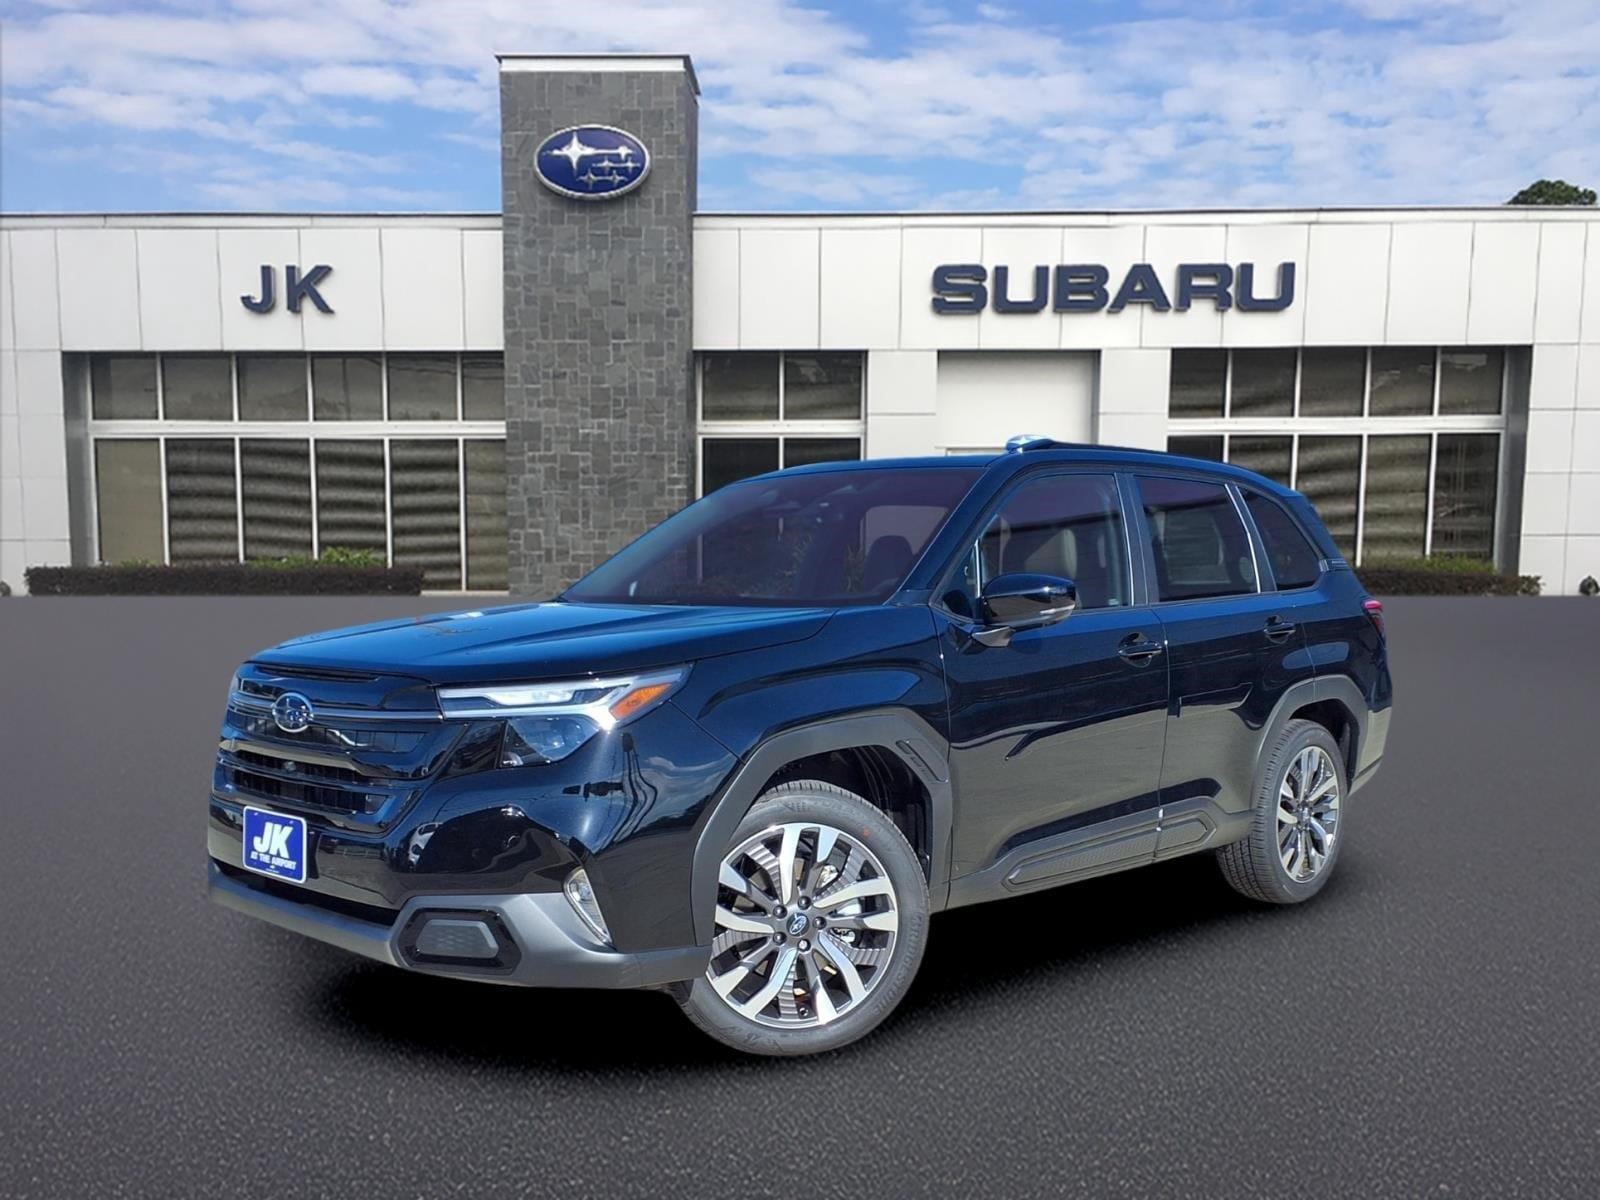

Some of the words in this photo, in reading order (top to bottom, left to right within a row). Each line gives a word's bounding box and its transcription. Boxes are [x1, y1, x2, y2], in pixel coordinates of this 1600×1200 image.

[240, 264, 335, 314] JK
[931, 262, 1296, 314] SUBARU
[253, 821, 293, 859] JK
[259, 853, 270, 864] THE
[271, 856, 297, 870] AIRPORT
